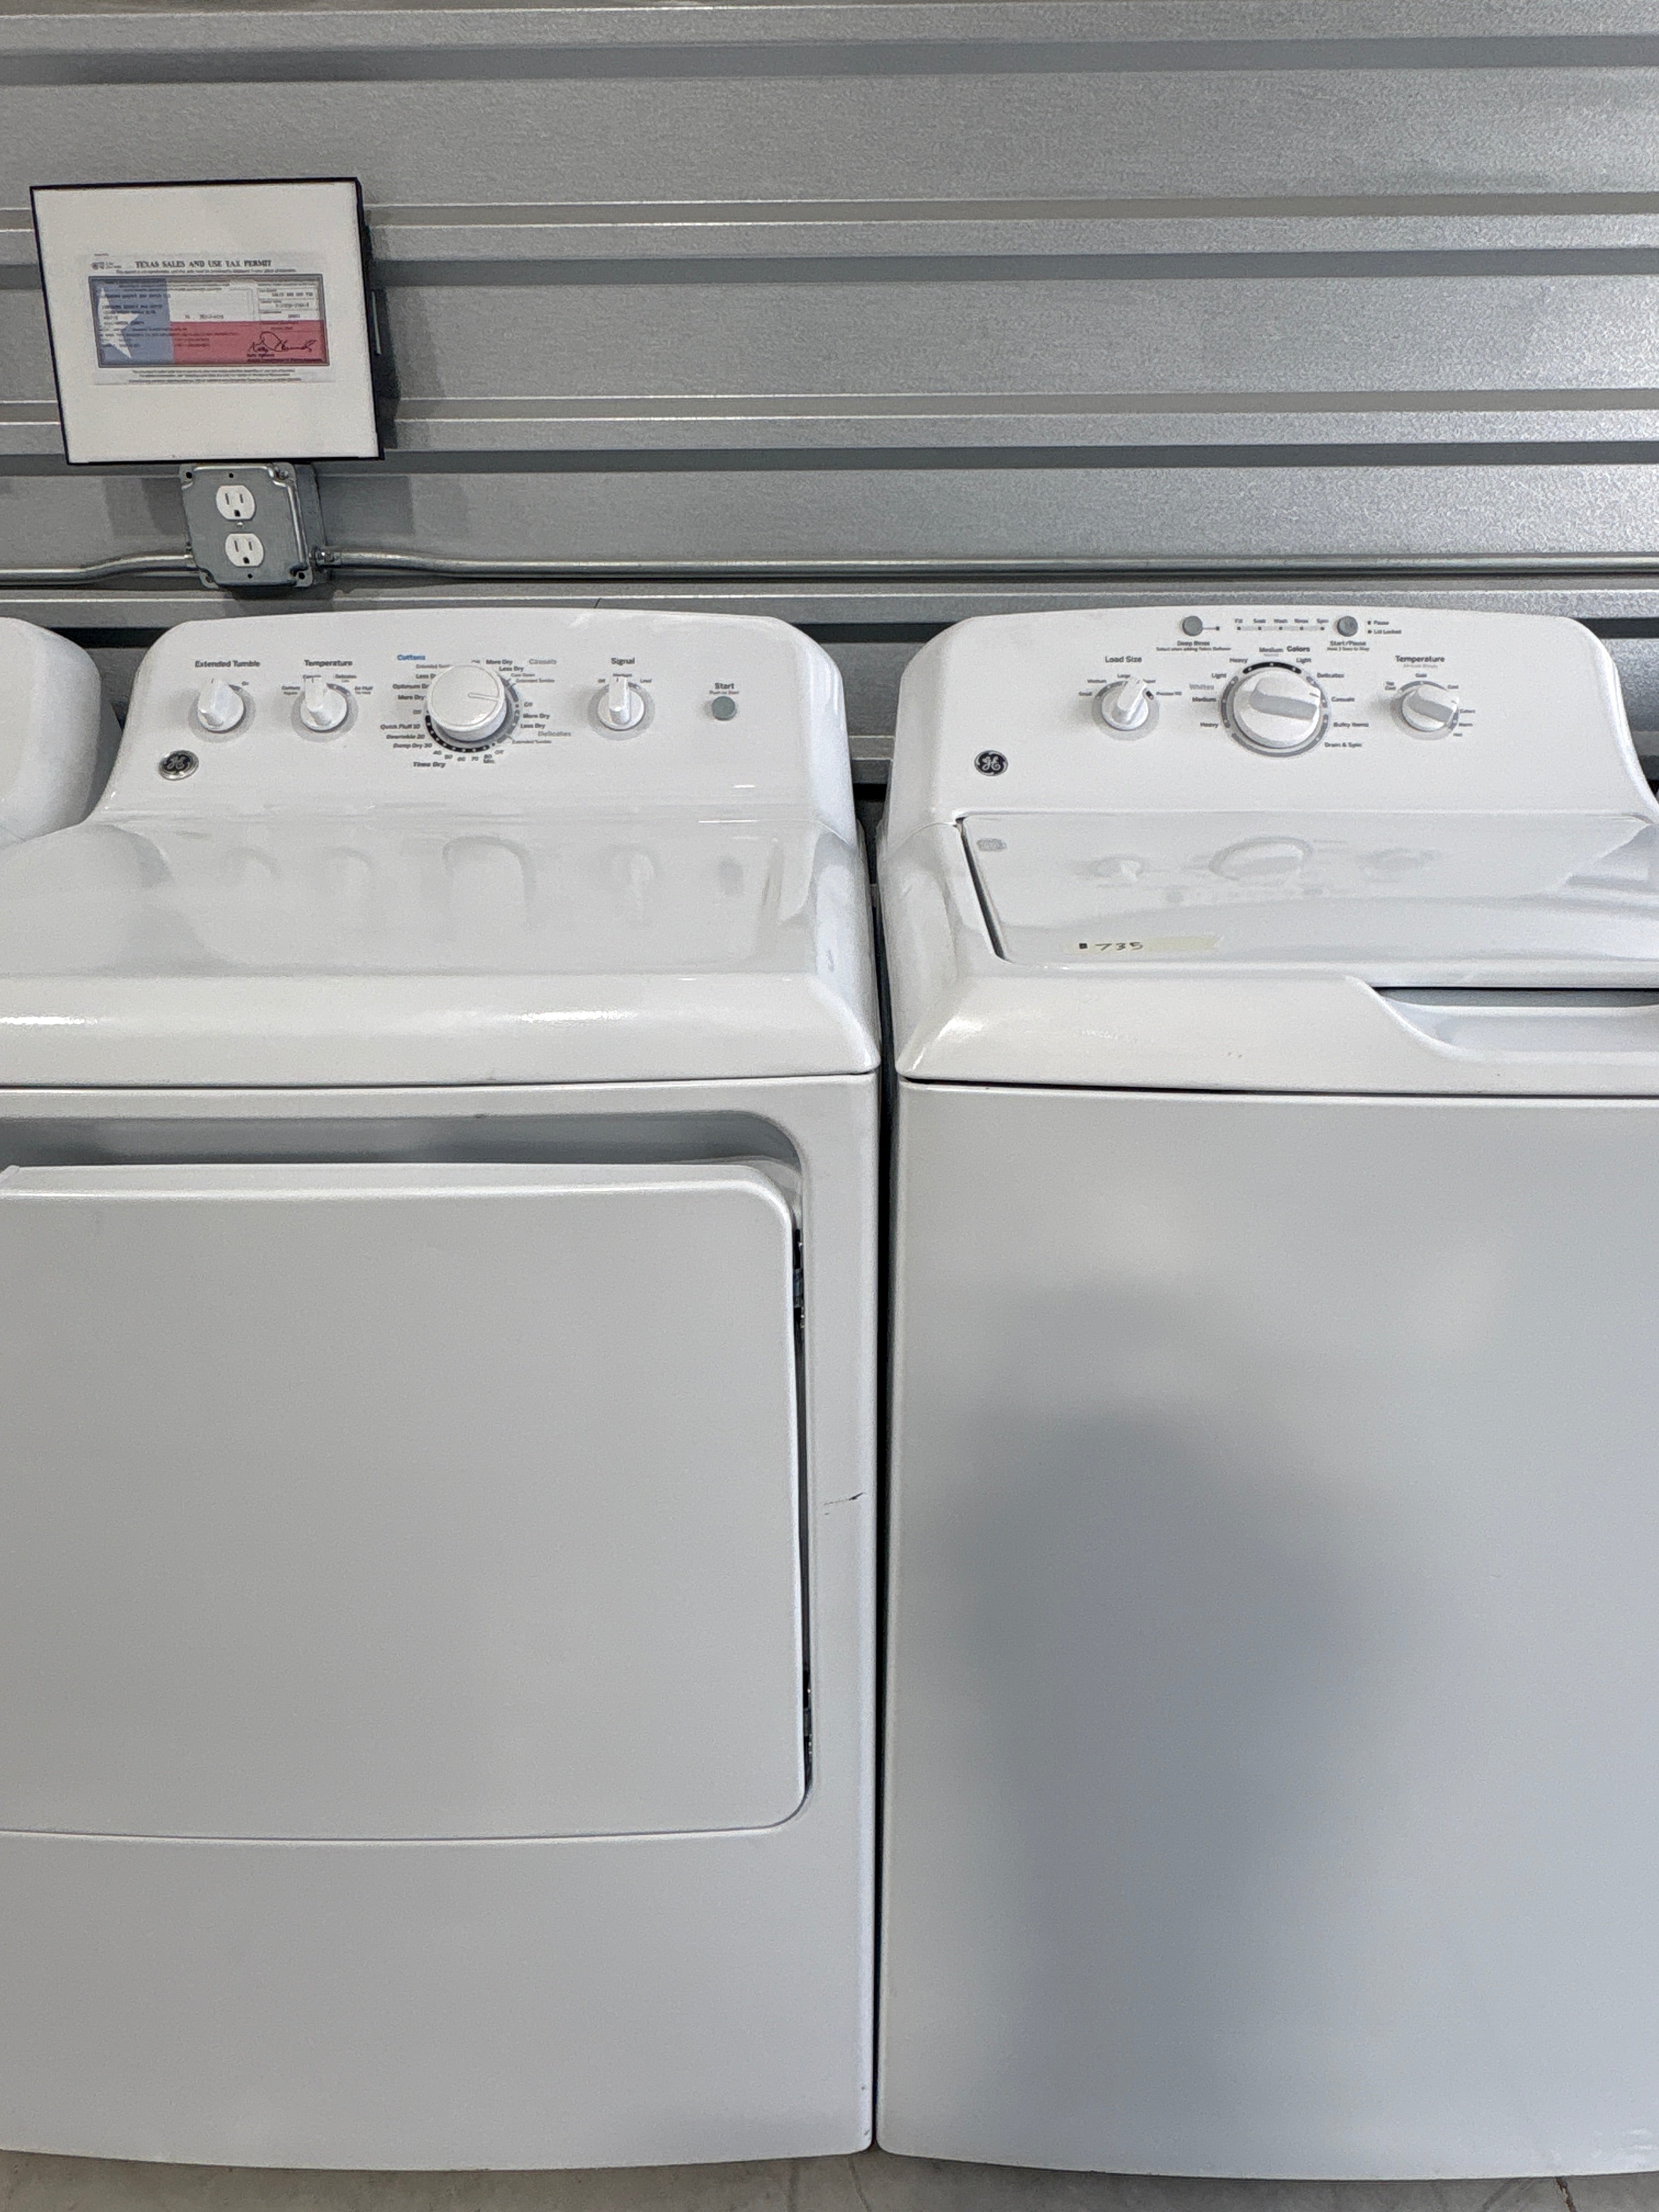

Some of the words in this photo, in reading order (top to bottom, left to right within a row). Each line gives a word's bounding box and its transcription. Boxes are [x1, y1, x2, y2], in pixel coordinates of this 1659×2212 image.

[135, 260, 159, 268] TEXAS
[244, 259, 272, 267] PERMIT
[611, 657, 635, 666] Signal
[1395, 655, 1445, 663] Temperature
